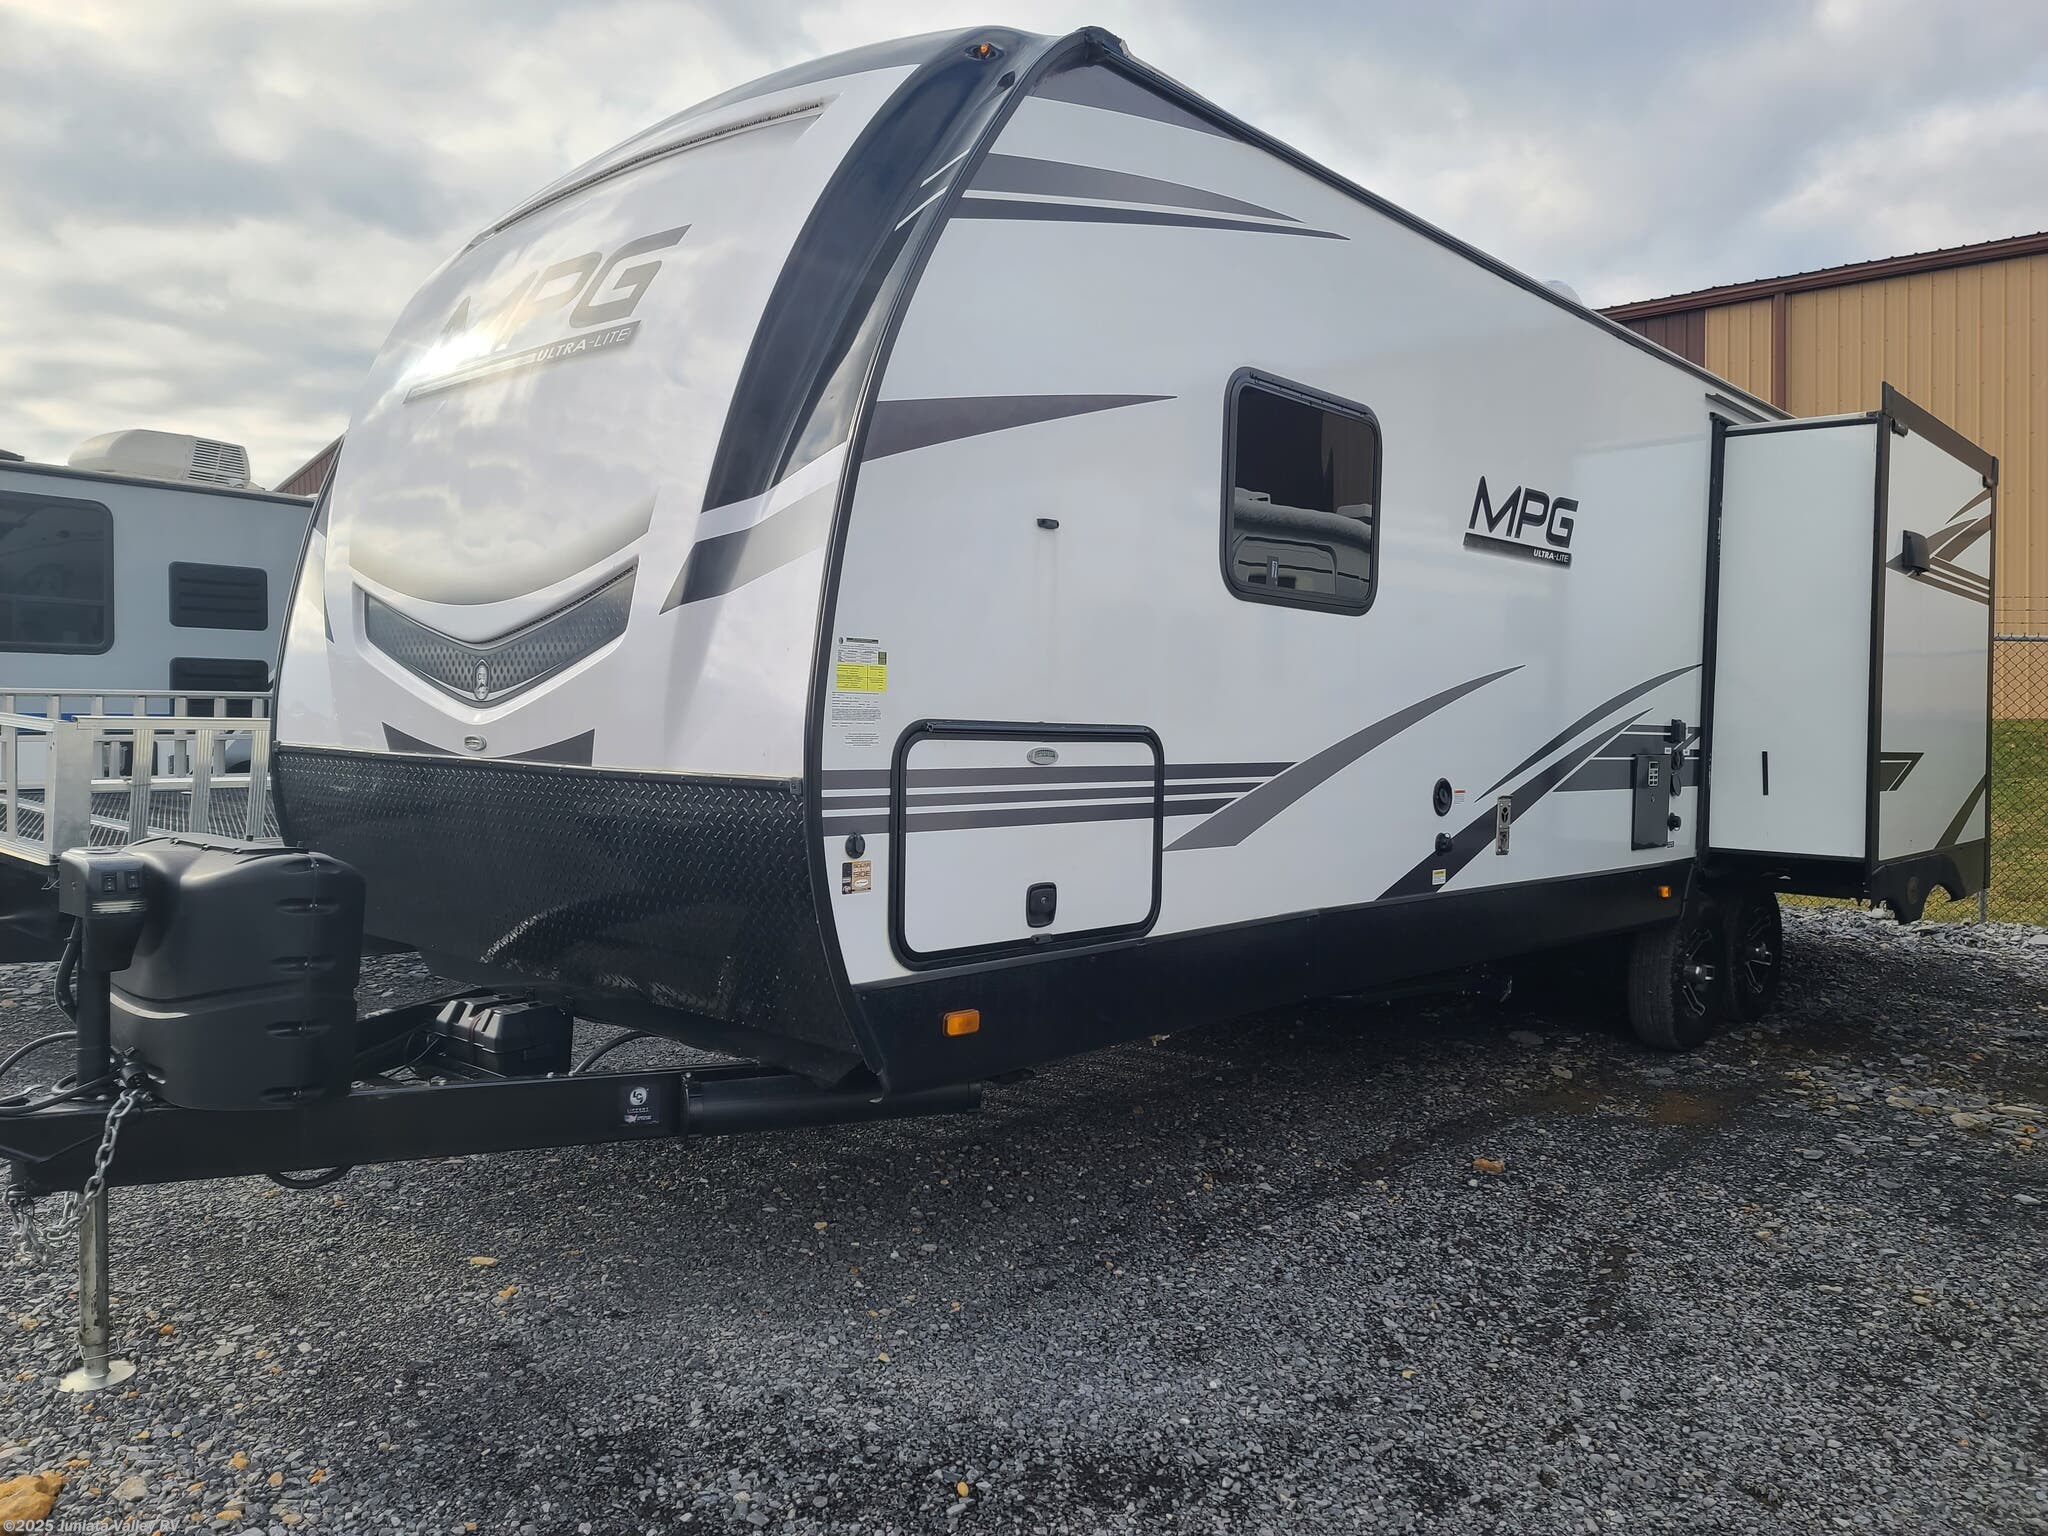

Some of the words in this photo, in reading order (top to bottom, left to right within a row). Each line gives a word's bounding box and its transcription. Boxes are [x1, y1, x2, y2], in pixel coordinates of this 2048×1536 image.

[536, 326, 631, 362] ULTRA-LITE
[1469, 475, 1579, 548] MPG
[1533, 549, 1569, 563] ULTRA-LITE
